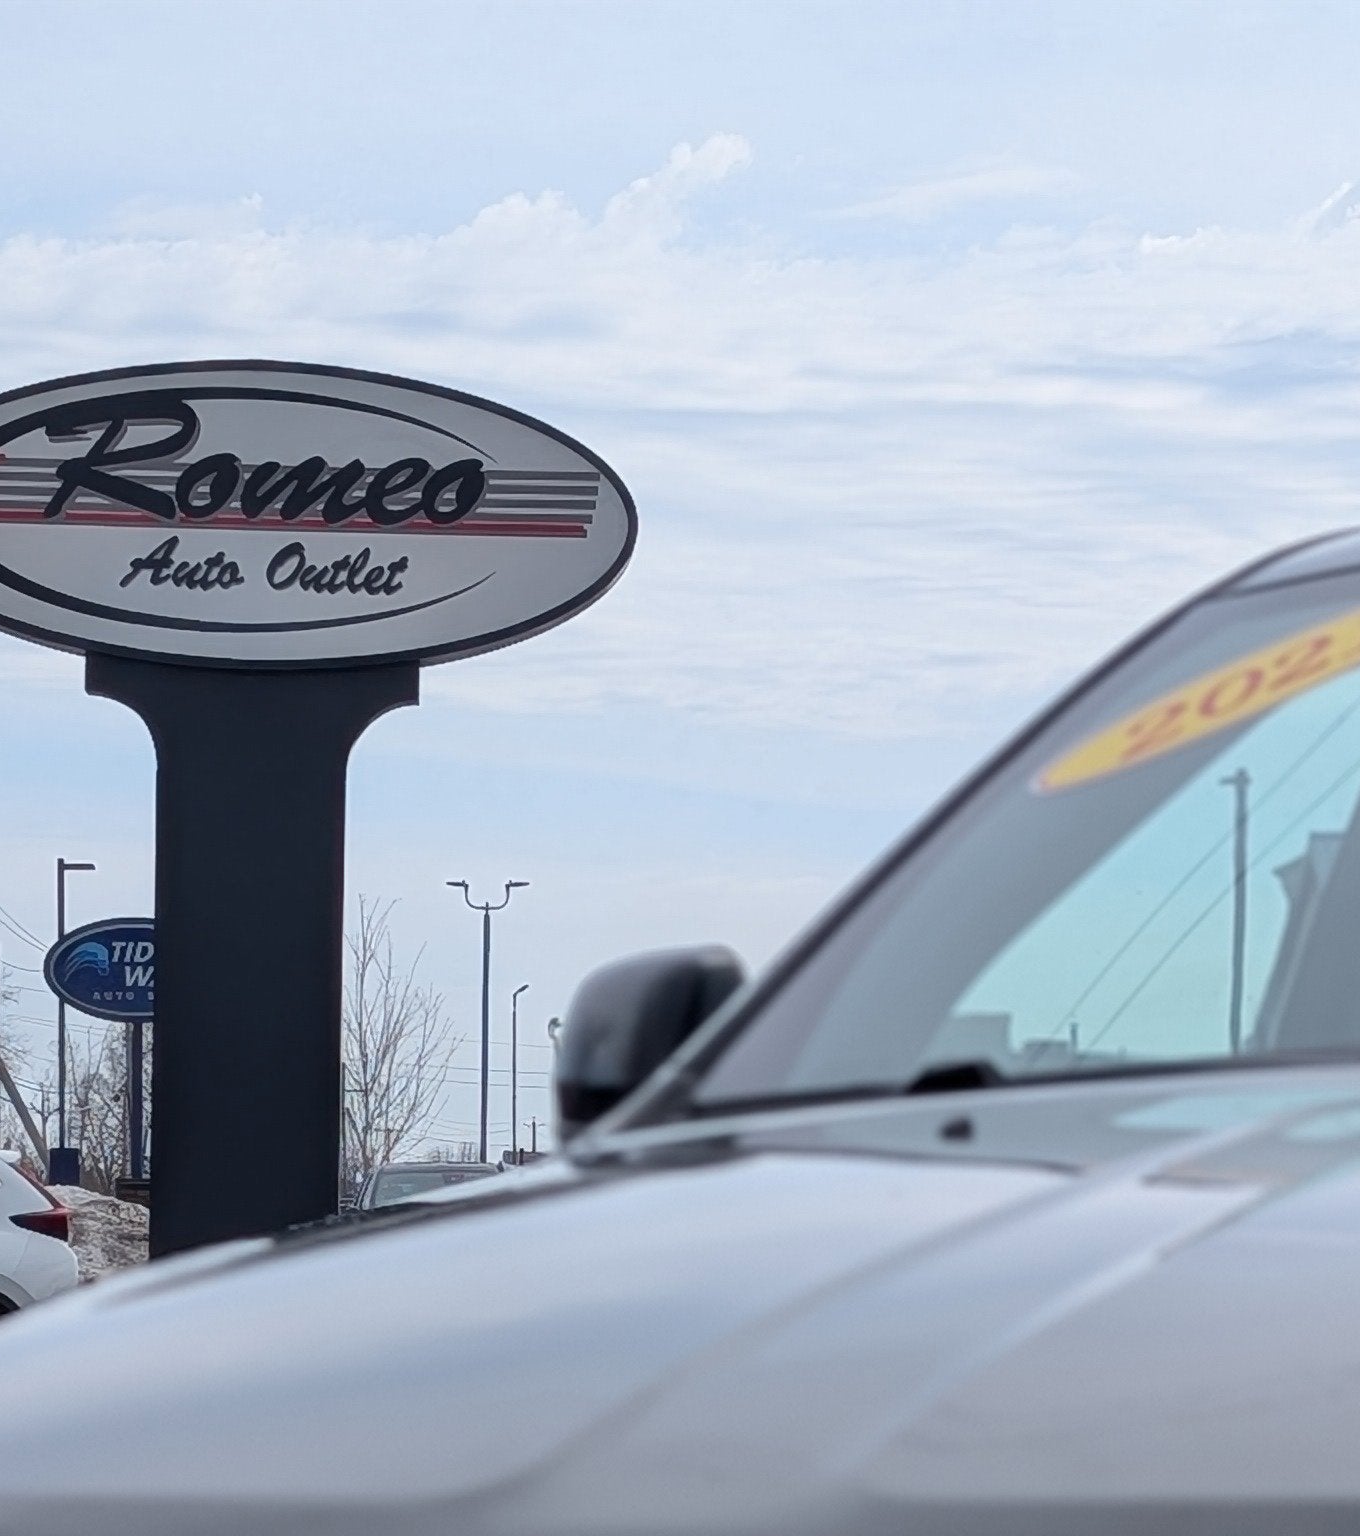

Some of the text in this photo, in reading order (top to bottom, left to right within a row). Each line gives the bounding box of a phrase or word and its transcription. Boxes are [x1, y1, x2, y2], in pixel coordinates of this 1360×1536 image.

[43, 398, 488, 527] Romeo
[119, 536, 409, 597] Auto Outlet
[111, 941, 155, 963] TID
[124, 965, 155, 987] W
[92, 991, 135, 1001] AUTO
